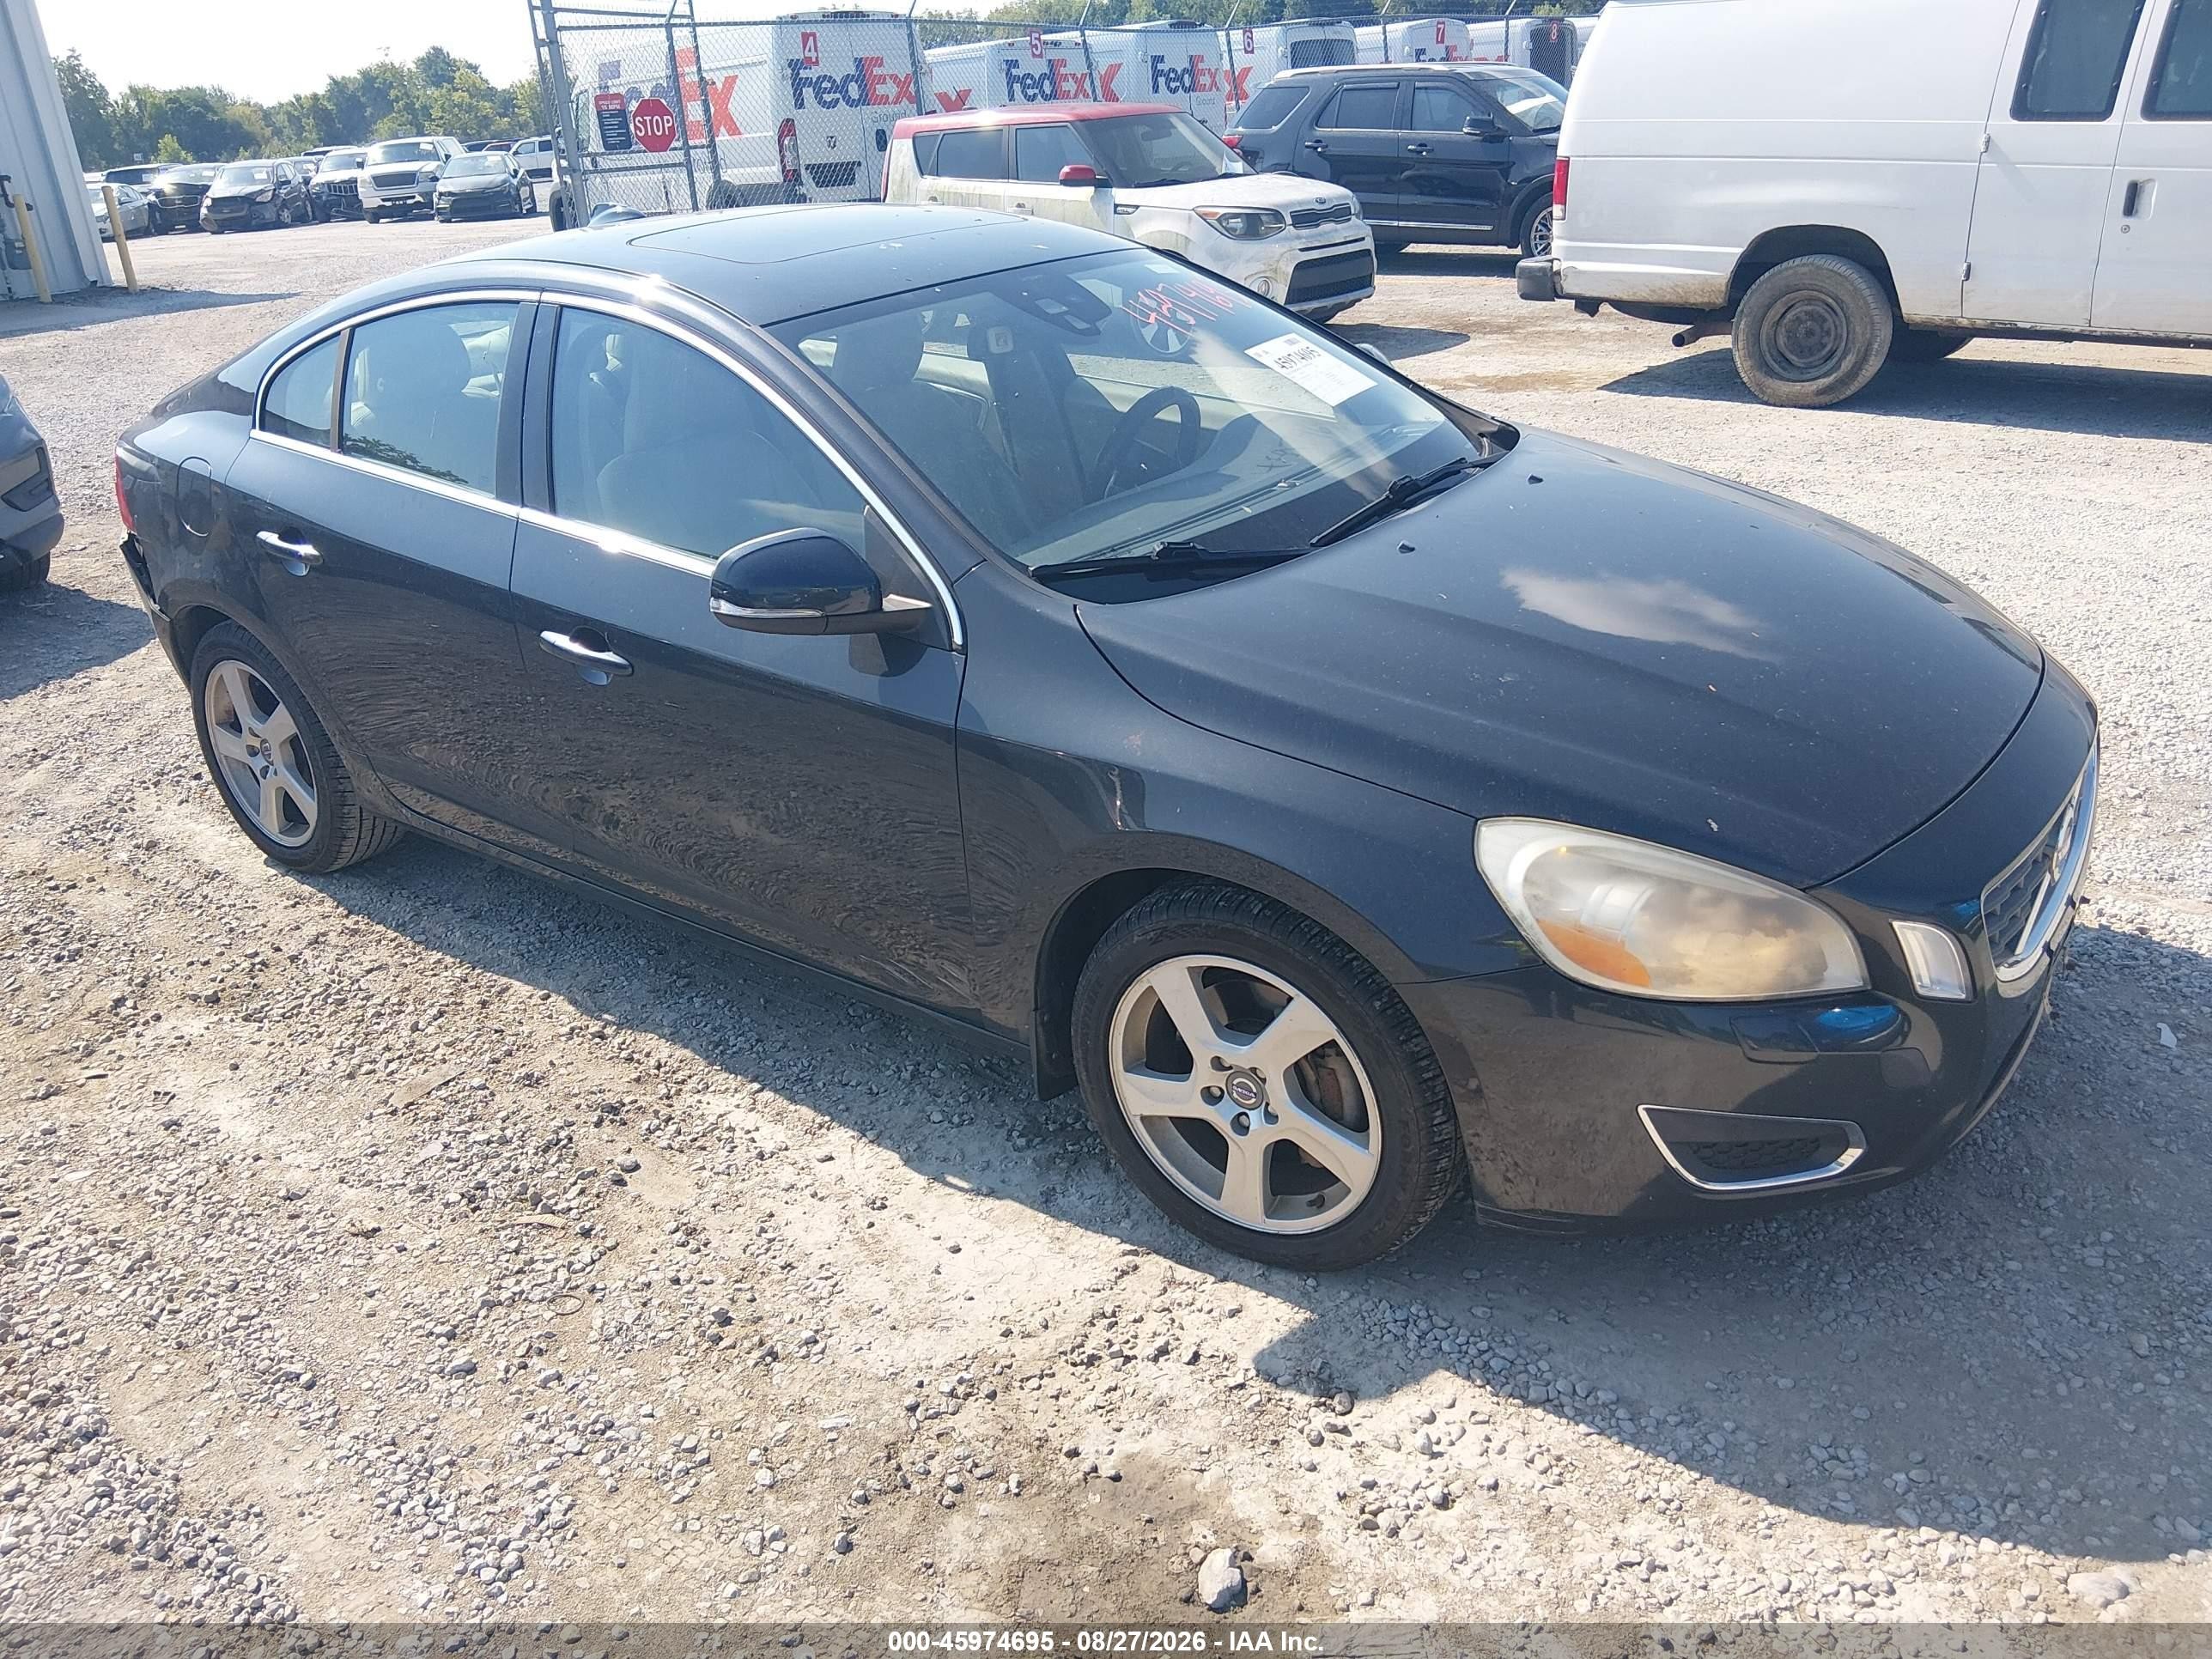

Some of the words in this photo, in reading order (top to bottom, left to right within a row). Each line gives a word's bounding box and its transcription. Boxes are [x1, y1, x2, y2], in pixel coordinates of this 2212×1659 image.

[1244, 31, 1253, 52] 6
[1437, 24, 1445, 41] 7
[1551, 23, 1559, 41] 8
[804, 35, 817, 63] 4
[1031, 33, 1042, 55] 5
[787, 56, 917, 109] FedEx
[1003, 58, 1091, 102] FedEx
[1151, 55, 1222, 94] FedEx
[635, 115, 673, 137] STOP
[1273, 346, 1322, 370] 45974695
